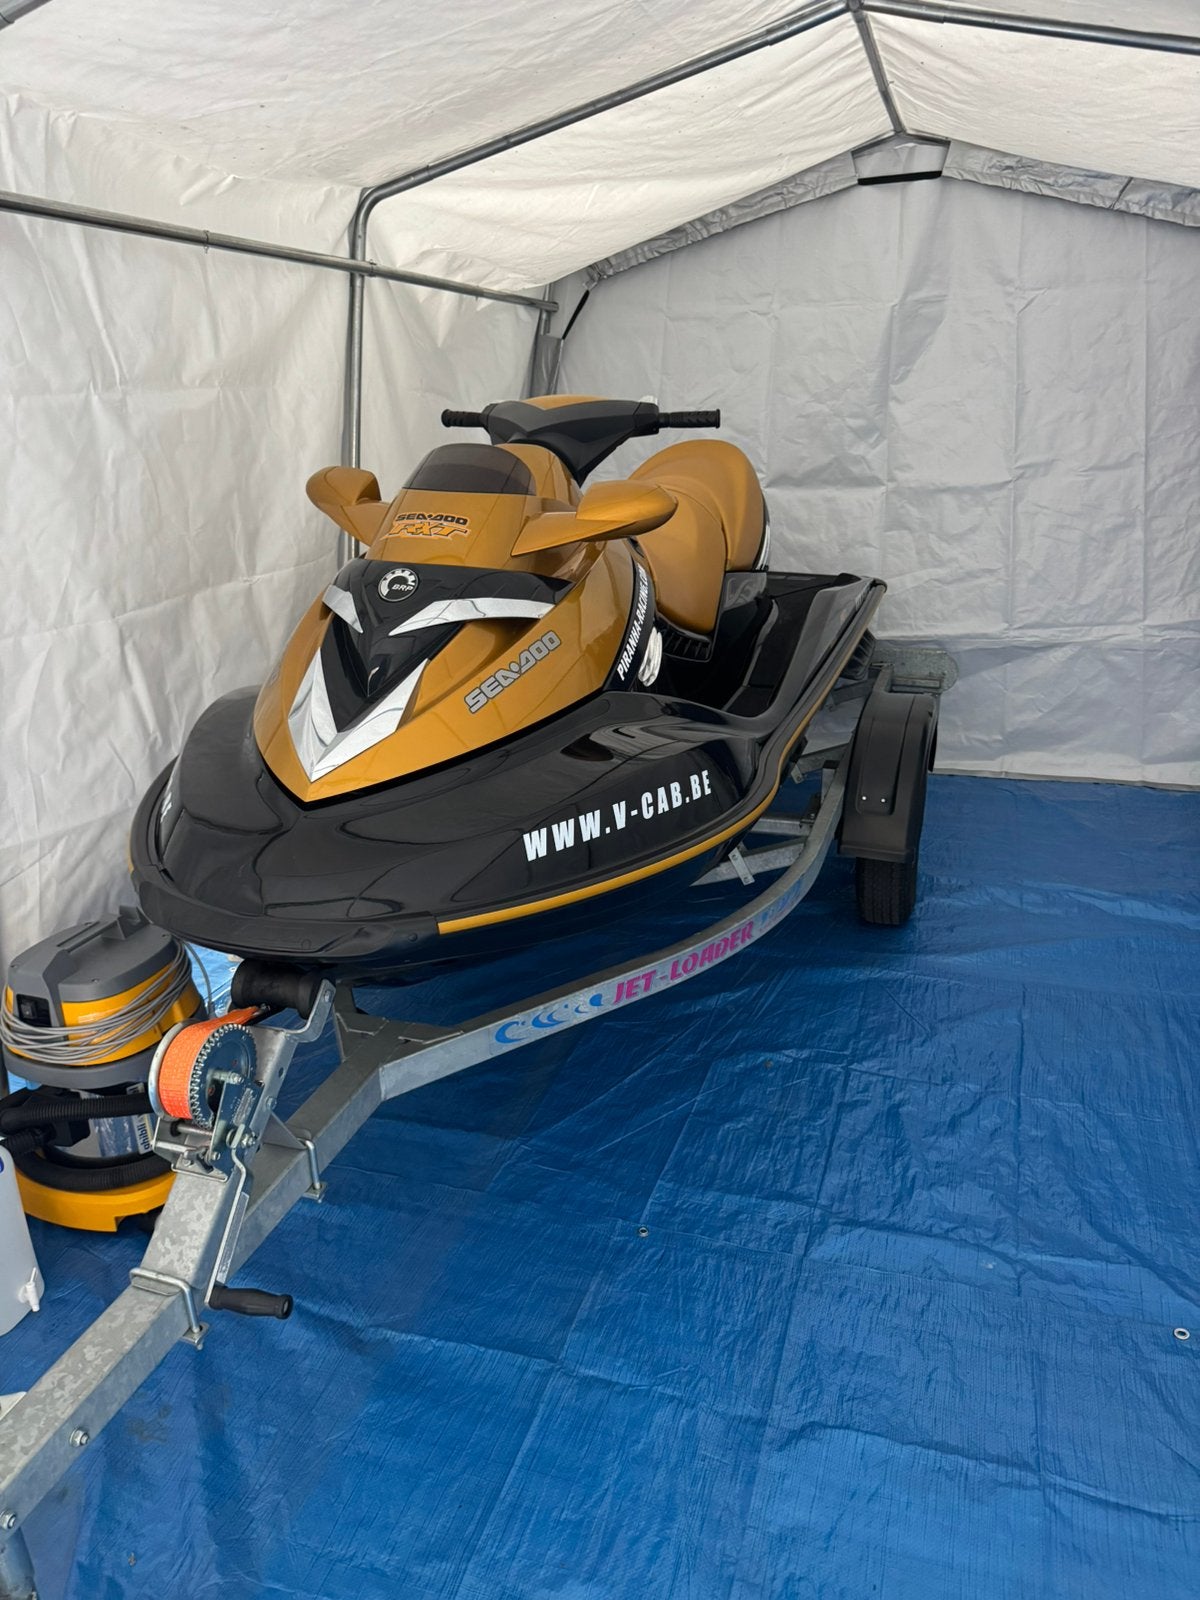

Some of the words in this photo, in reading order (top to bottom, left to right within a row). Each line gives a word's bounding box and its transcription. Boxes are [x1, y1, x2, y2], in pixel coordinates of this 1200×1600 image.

[387, 521, 468, 537] RXT
[391, 583, 414, 592] BRP
[522, 769, 712, 862] WWW.V-CAB.BE
